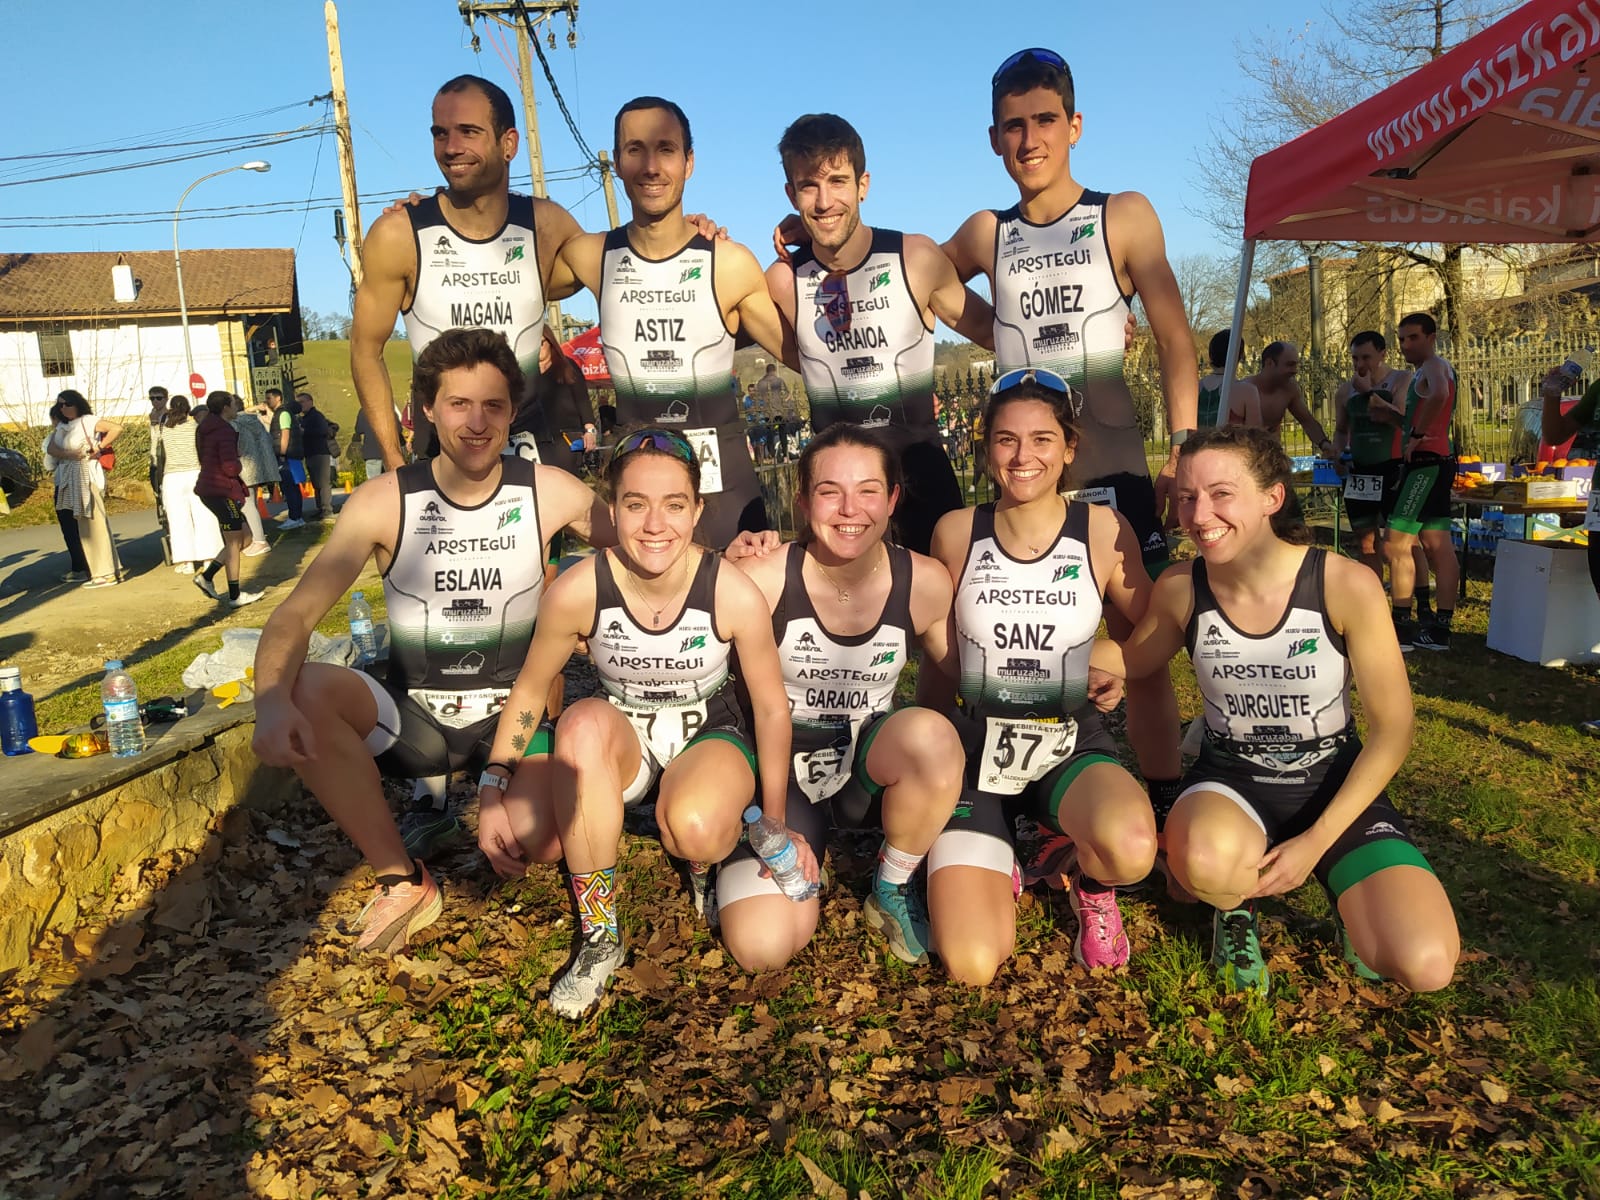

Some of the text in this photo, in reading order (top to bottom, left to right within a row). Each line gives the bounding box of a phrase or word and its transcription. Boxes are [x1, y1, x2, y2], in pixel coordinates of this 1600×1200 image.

[451, 296, 513, 326] MAGAÑA
[1020, 281, 1085, 320] GÓMEZ
[634, 318, 686, 342] ASTIZ
[825, 325, 889, 353] GARAIOA
[435, 567, 503, 592] ESLAVA
[993, 622, 1056, 651] SANZ
[806, 688, 869, 709] GARAIOA
[1224, 693, 1311, 719] BURGUETE
[992, 732, 1043, 771] 57
